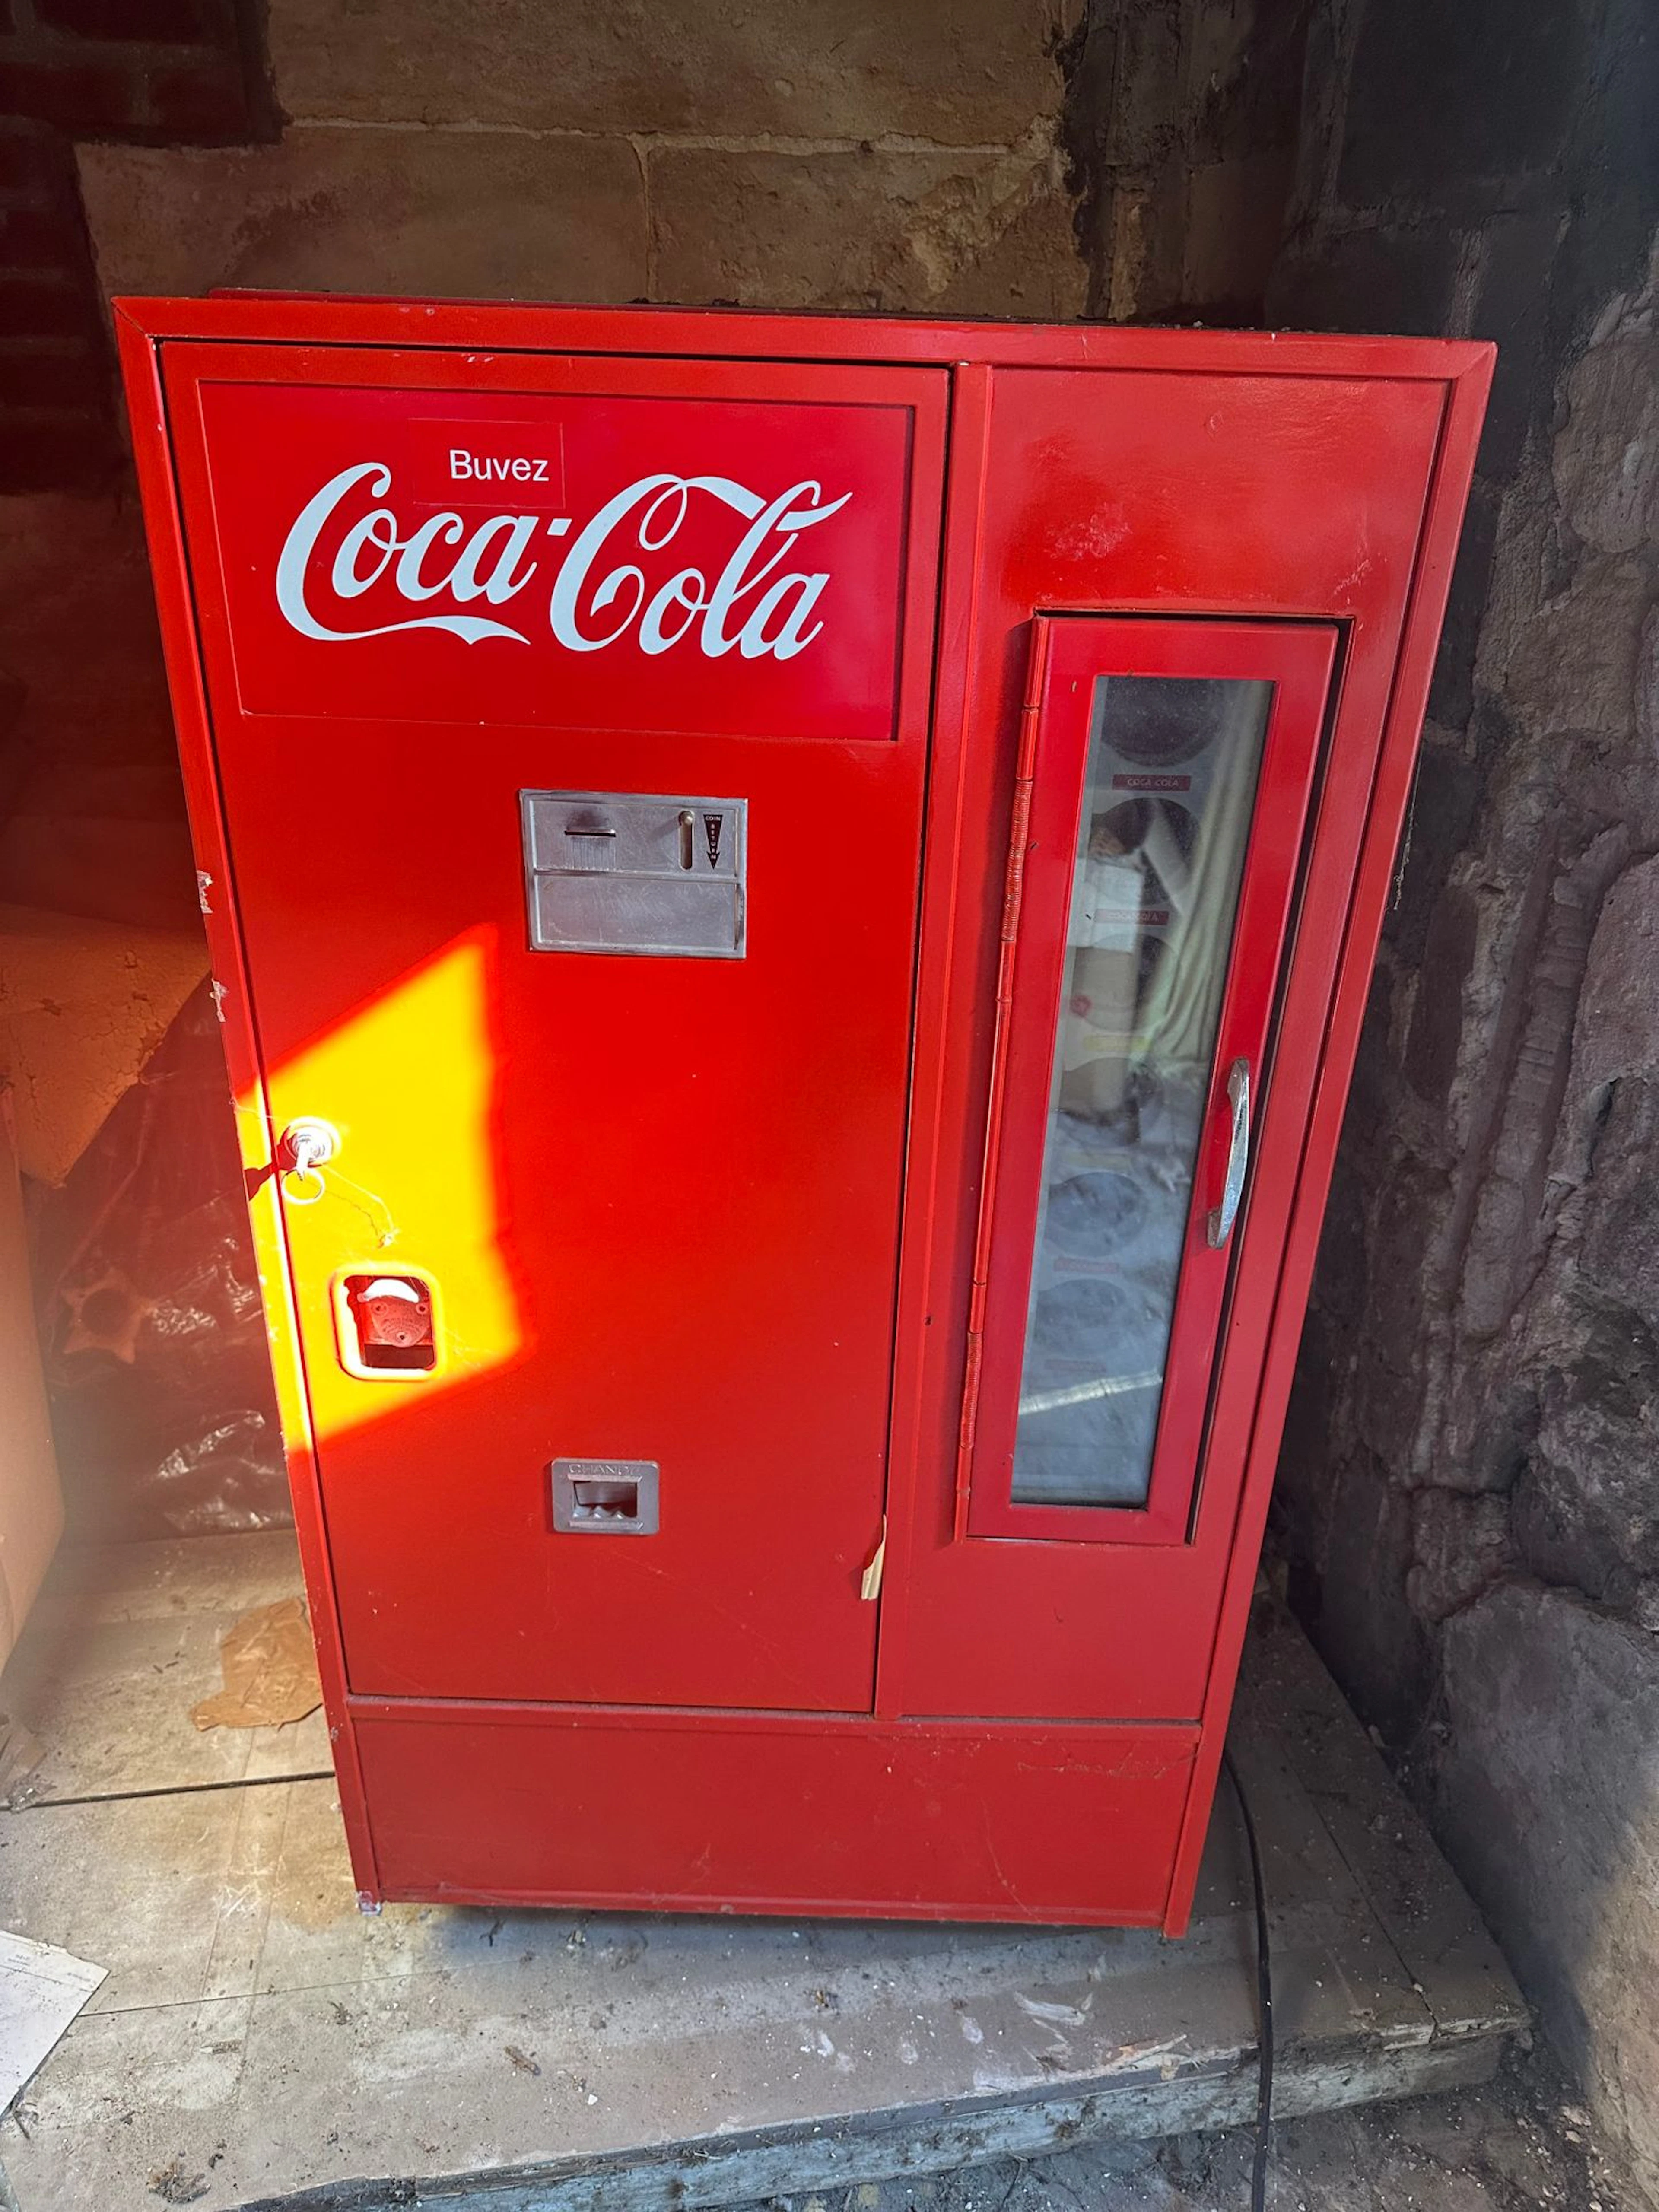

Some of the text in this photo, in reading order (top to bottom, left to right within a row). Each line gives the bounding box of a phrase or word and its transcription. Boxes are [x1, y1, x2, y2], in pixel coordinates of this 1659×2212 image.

[449, 449, 549, 481] Buvez
[276, 462, 853, 660] Coca-Cola
[1127, 778, 1179, 787] COCA COLA
